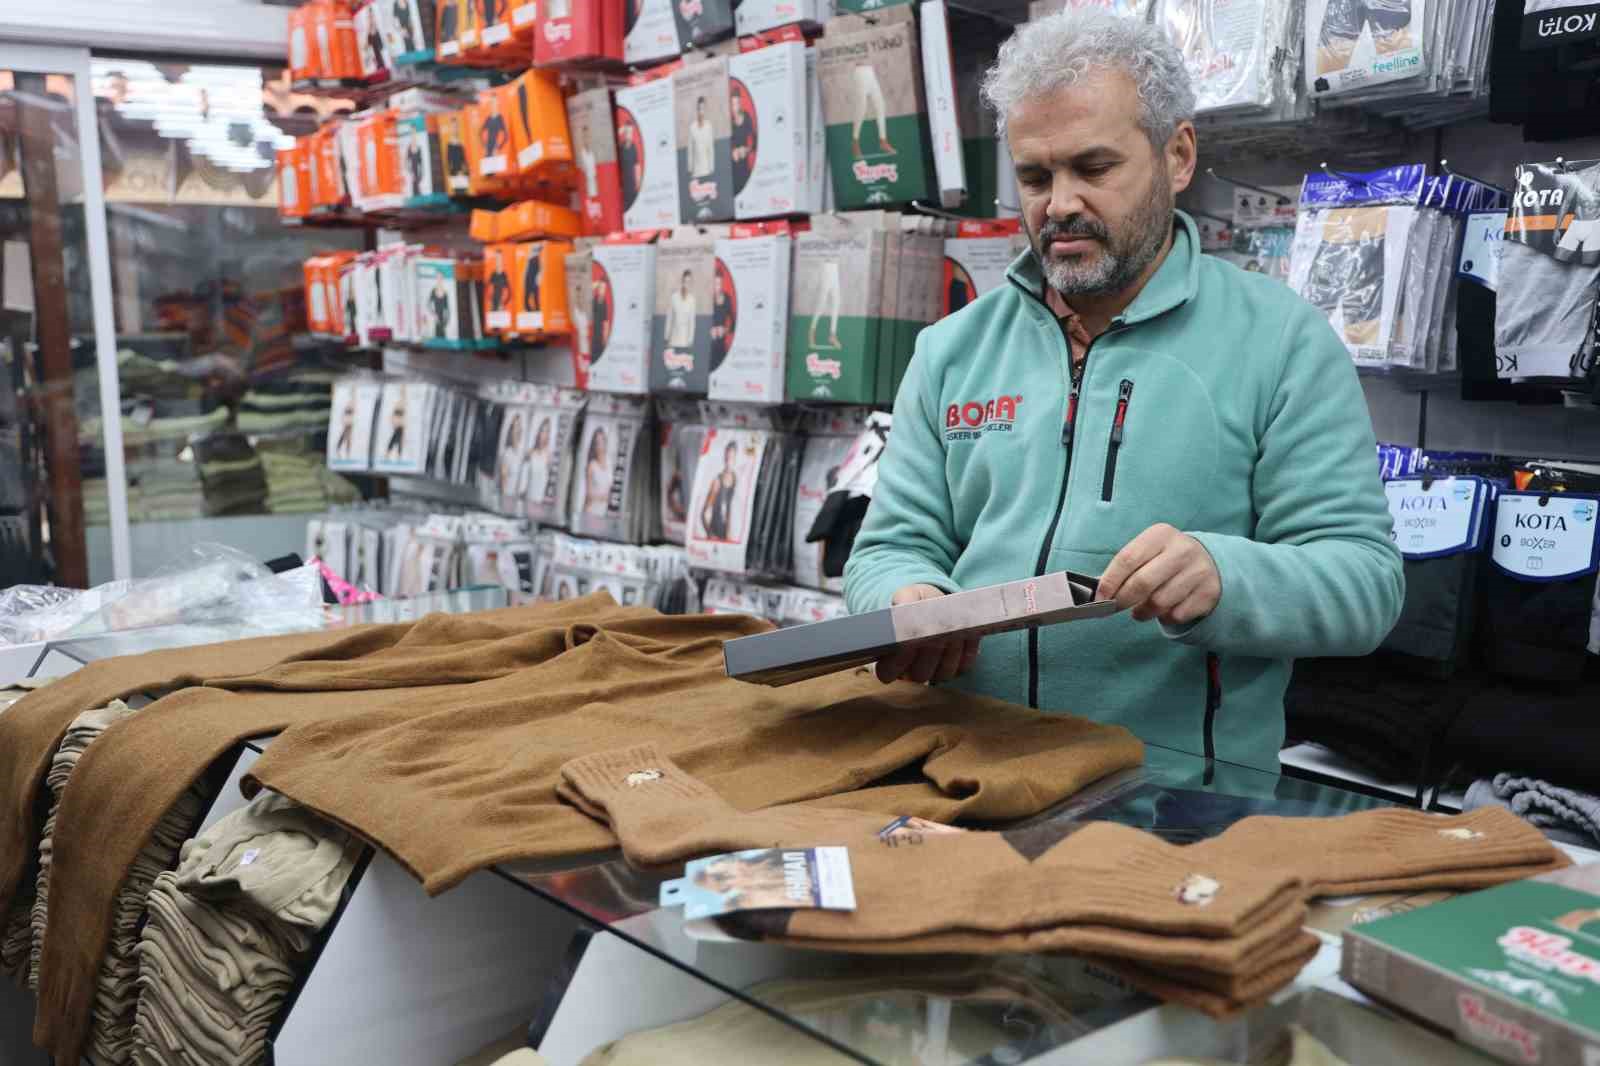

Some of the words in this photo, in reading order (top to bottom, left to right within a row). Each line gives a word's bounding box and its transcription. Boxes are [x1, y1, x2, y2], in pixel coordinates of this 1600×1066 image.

[1538, 12, 1597, 37] KOTA
[1371, 54, 1420, 75] feelline
[1512, 188, 1565, 208] KOTA
[1400, 495, 1447, 511] KOTA
[1514, 513, 1568, 532] KOTA
[1520, 537, 1556, 550] BOXER
